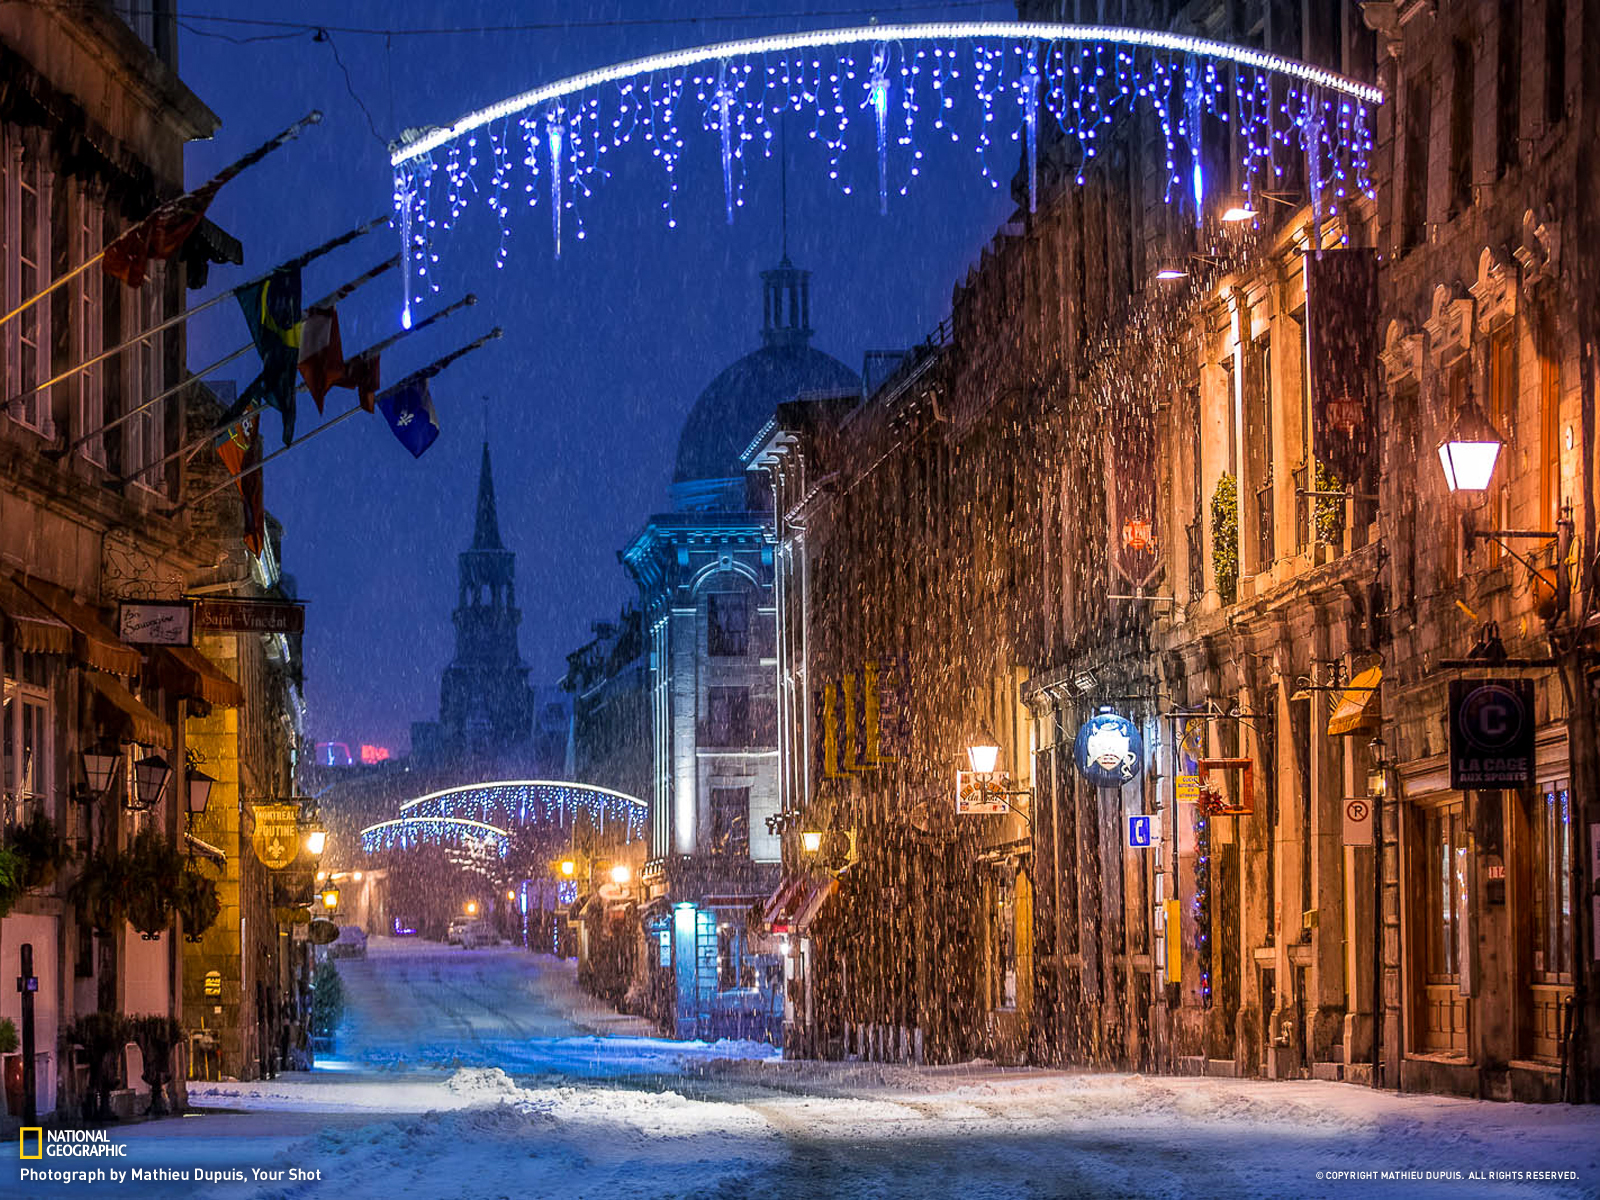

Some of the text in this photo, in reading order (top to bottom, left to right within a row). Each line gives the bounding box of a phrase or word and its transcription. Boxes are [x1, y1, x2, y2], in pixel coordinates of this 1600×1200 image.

[1458, 757, 1528, 772] LA CAGE
[1460, 772, 1528, 782] AUX SPORTS
[256, 825, 295, 837] POUTINE
